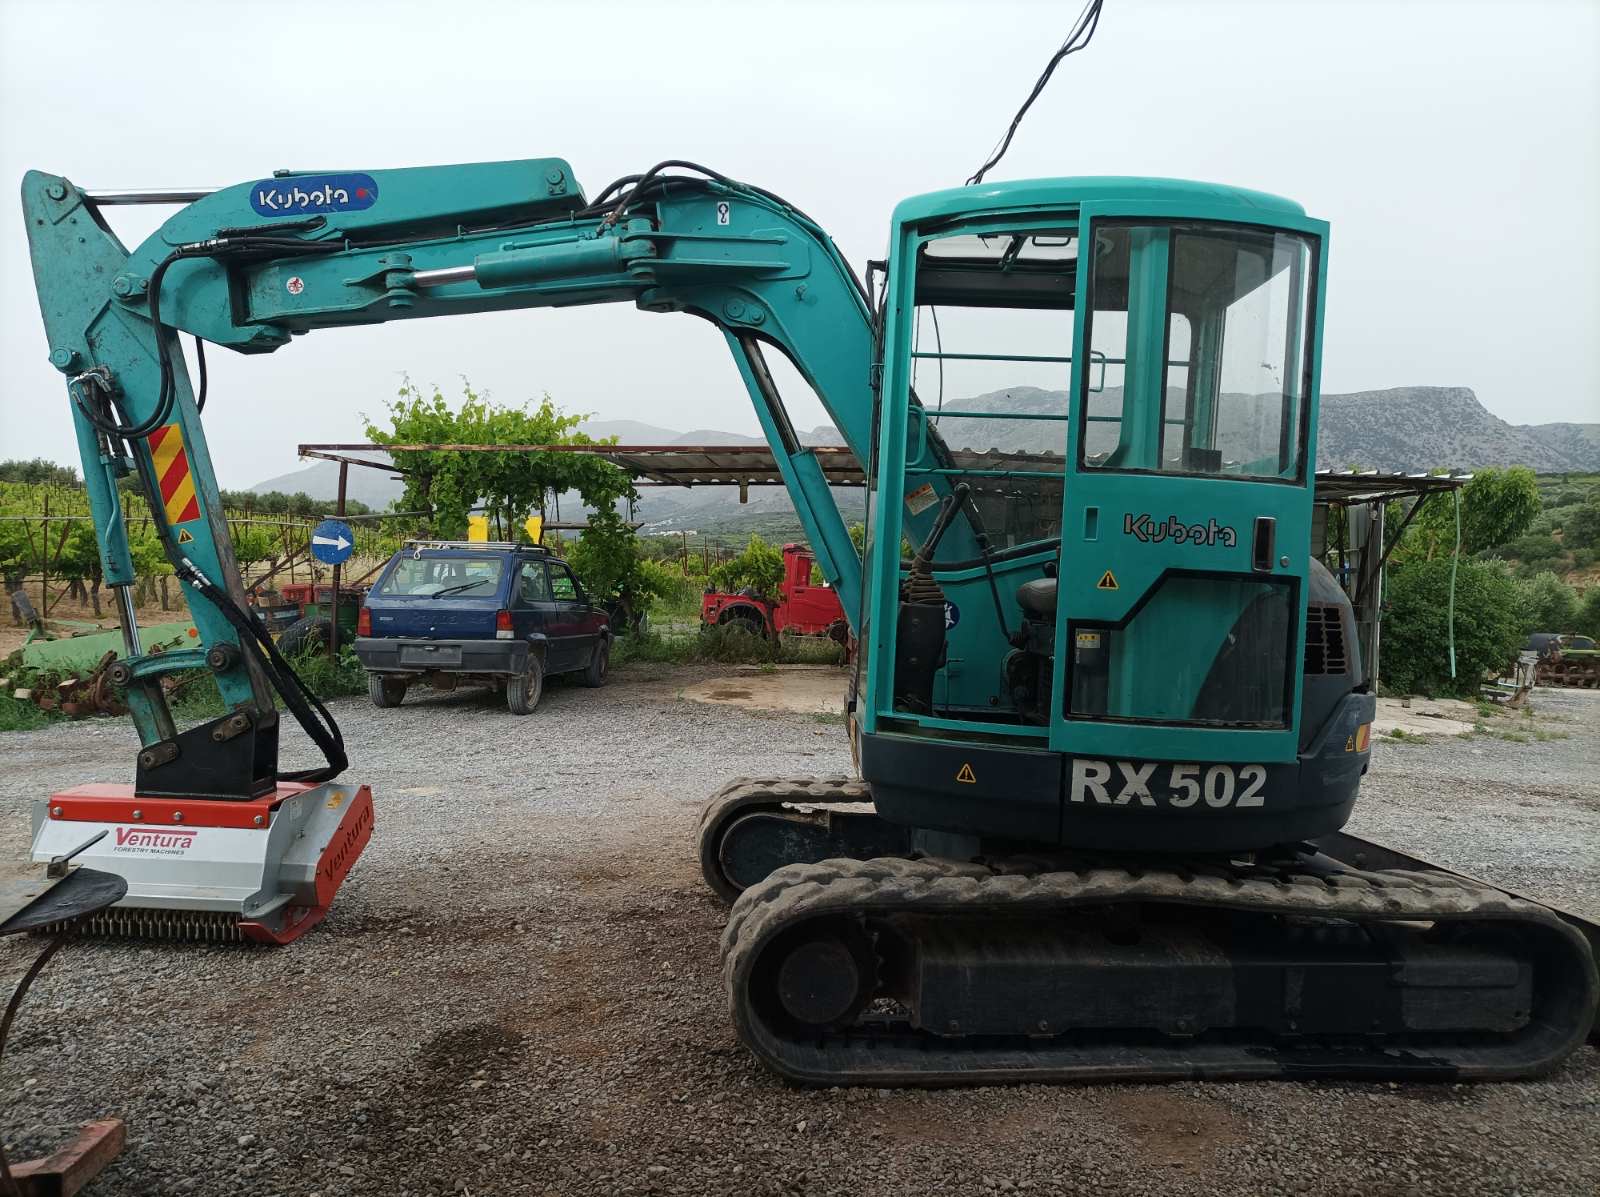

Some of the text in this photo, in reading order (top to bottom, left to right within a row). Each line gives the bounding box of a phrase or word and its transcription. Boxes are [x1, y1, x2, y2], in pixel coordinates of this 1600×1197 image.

[259, 184, 349, 210] Kubota
[1123, 513, 1237, 547] Kubota
[1070, 758, 1267, 808] RX 502
[113, 846, 185, 856] FORESTRY MACHINES
[115, 826, 198, 849] Ventura
[324, 805, 371, 881] Ventura
